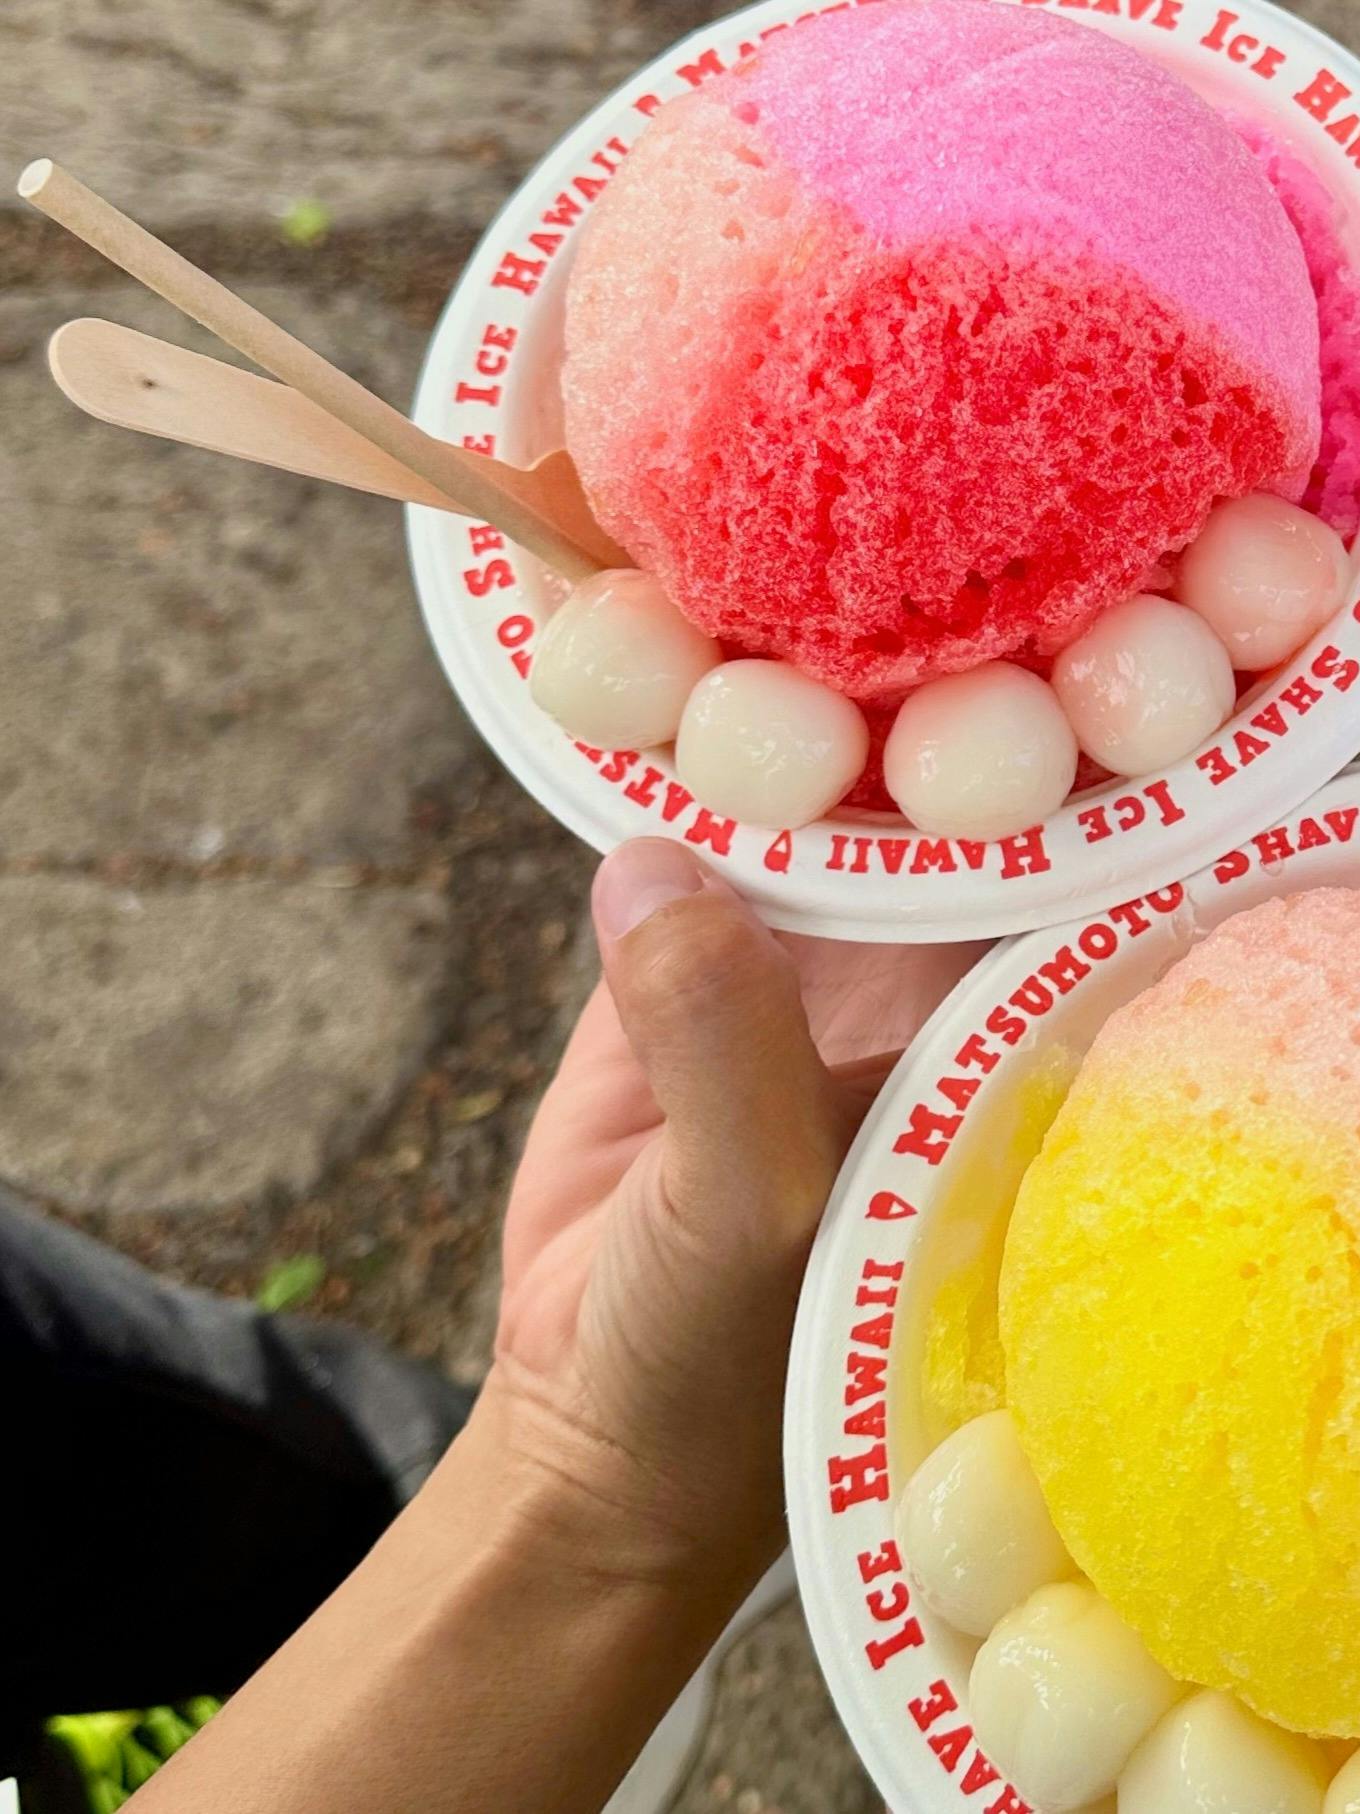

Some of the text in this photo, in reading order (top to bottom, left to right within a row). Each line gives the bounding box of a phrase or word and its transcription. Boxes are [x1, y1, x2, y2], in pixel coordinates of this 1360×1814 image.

[1201, 10, 1286, 80] ICE
[492, 137, 628, 295] HAWAII
[456, 324, 518, 407] ICE
[463, 434, 516, 597] SHE
[1196, 645, 1360, 787] SHAVE
[825, 824, 1052, 880] HAWAII
[1078, 780, 1186, 844] ICE
[893, 881, 1184, 1165] MATSUMOTO
[827, 1259, 905, 1515] HAWAII
[858, 1540, 925, 1671] ICE
